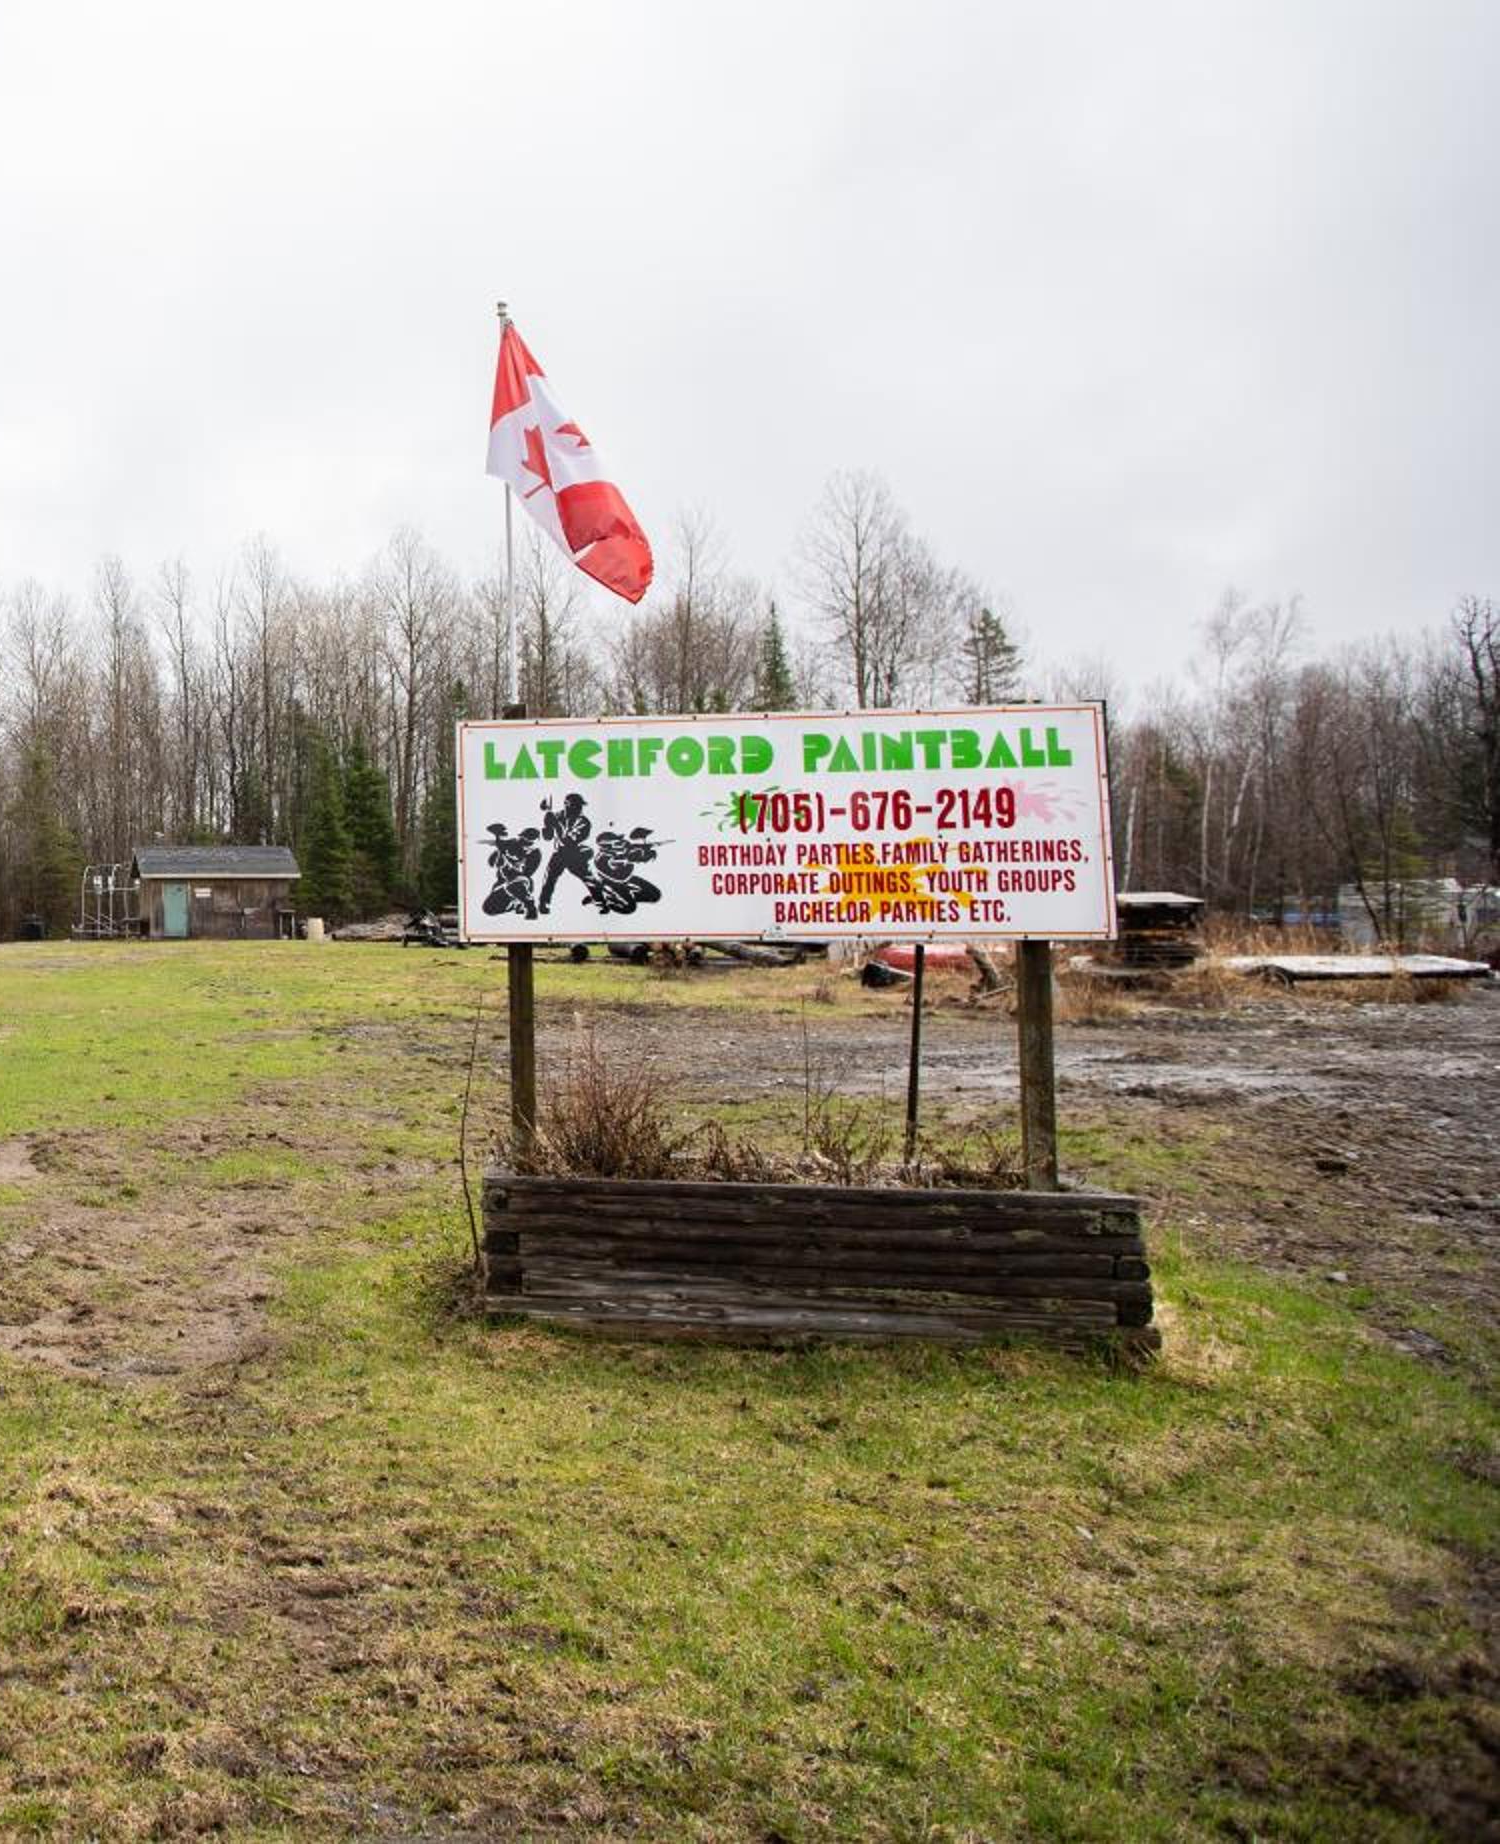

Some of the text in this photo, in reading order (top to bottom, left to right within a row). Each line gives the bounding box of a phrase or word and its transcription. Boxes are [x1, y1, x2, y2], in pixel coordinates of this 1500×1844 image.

[483, 727, 1073, 781] LATCHFORD PAINTBALL
[738, 787, 1017, 834] (705)-676-2149
[698, 844, 787, 867] BIRTHDAY
[958, 838, 1090, 864] GATHERINGS,
[712, 869, 1076, 895] CORPORATE OUTINGS, YOUTH GROUPS
[774, 899, 1011, 923] BACHELOR PARTIES ETC.
